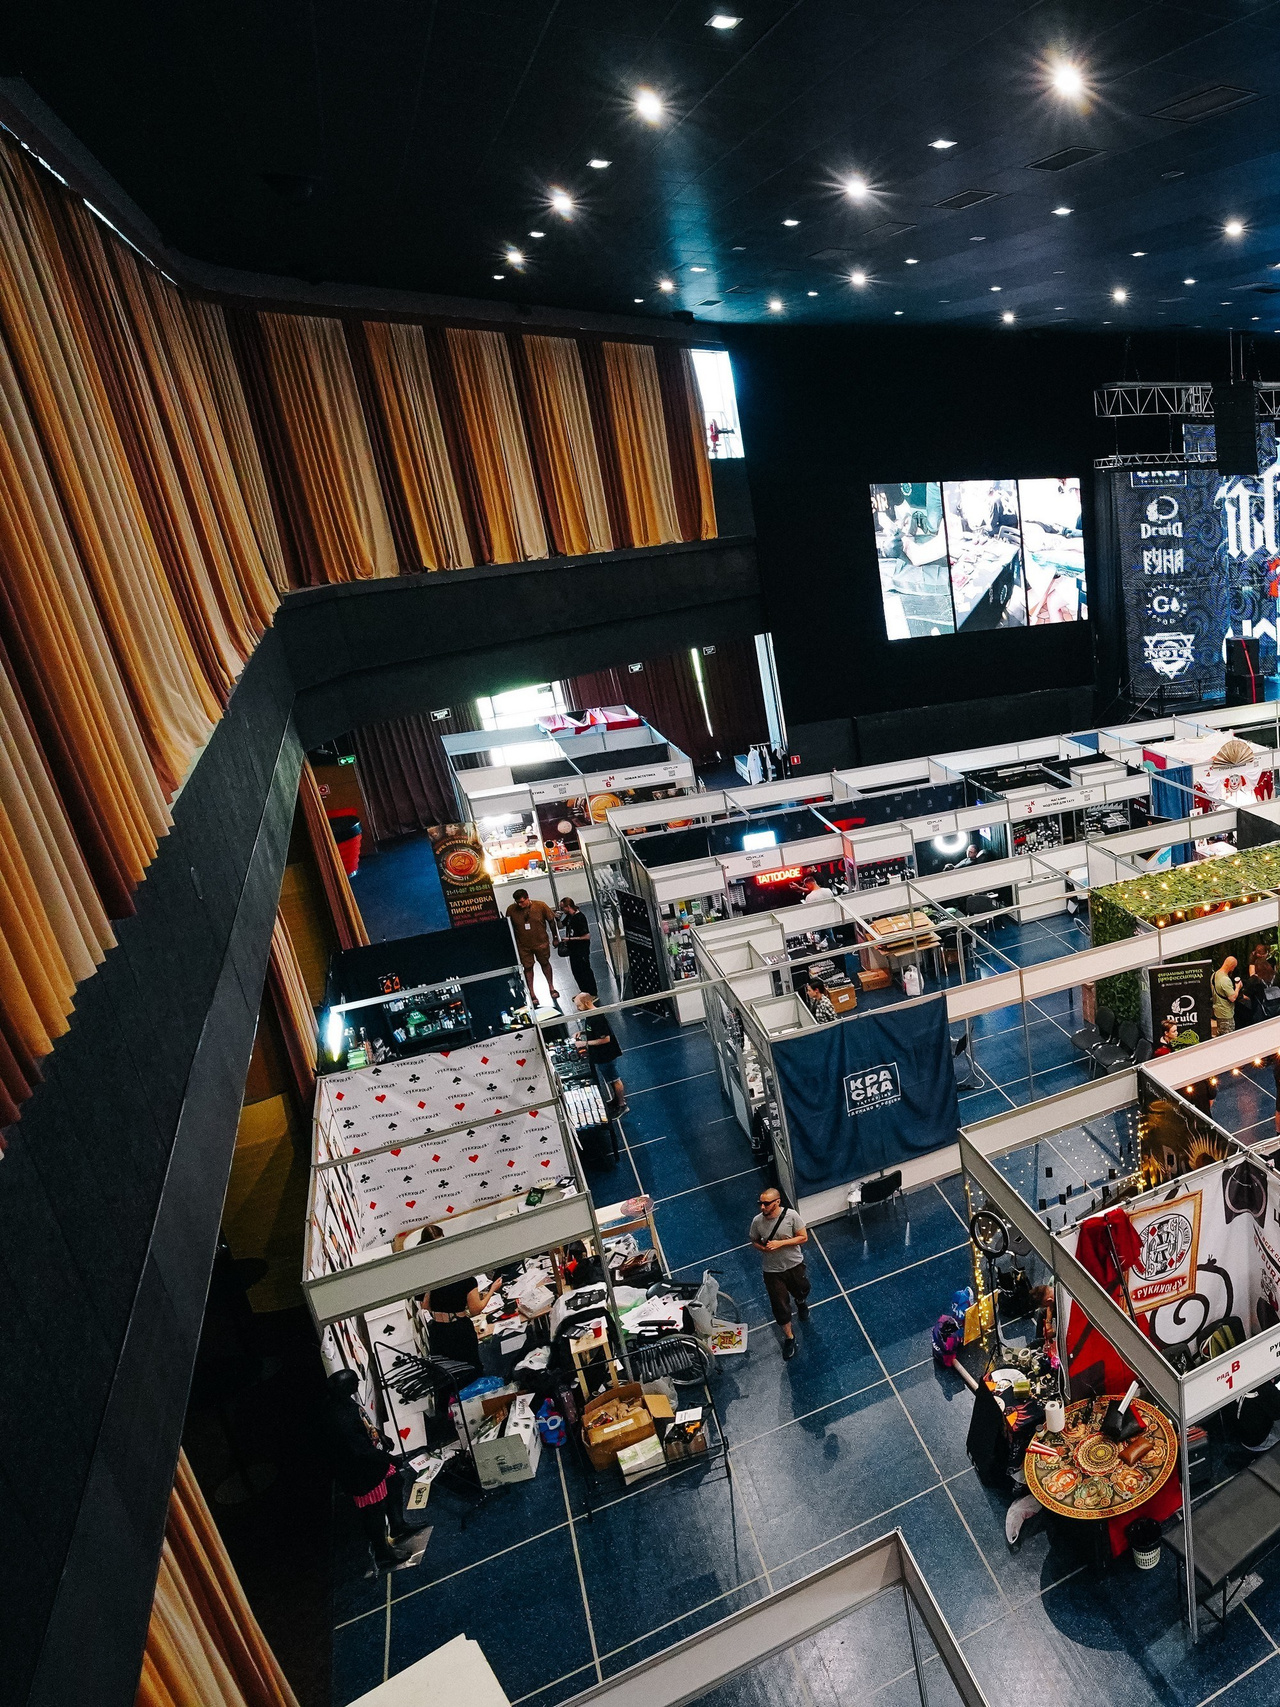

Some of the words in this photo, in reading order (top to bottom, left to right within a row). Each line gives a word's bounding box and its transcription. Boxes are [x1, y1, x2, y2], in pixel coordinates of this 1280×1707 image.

[756, 867, 801, 885] TATTOOAGE
[449, 895, 493, 908] ТАТУИРОВКА
[451, 904, 483, 915] ПИРСИНГ
[849, 1070, 893, 1091] КРА
[851, 1080, 894, 1101] СКА
[848, 1105, 874, 1117] СДЕЛАНО
[1216, 1371, 1230, 1382] РЯД
[1225, 1375, 1234, 1390] 1
